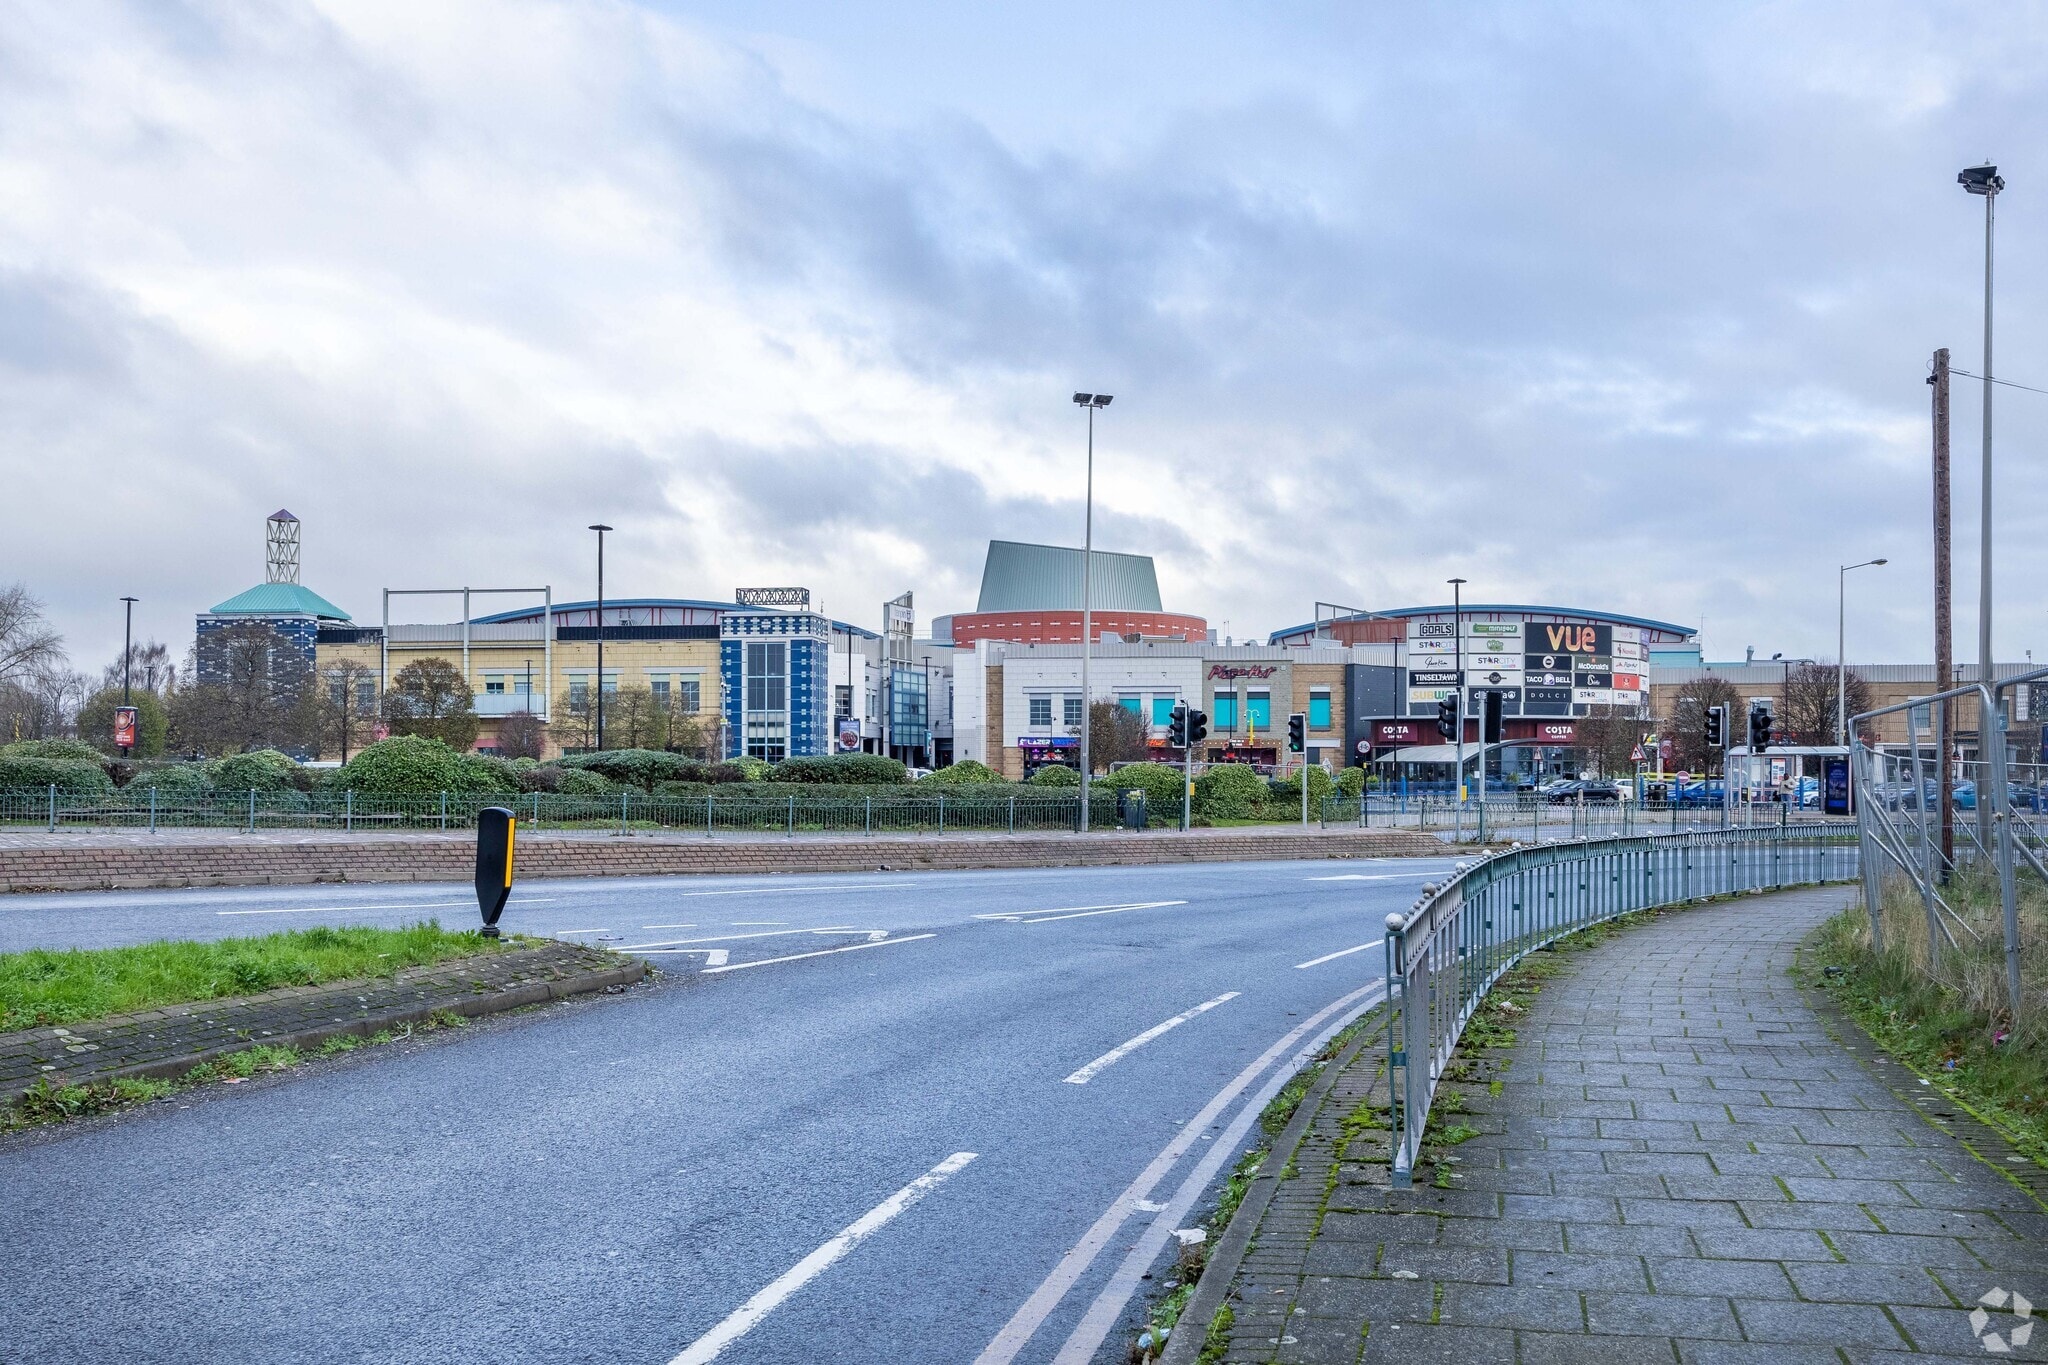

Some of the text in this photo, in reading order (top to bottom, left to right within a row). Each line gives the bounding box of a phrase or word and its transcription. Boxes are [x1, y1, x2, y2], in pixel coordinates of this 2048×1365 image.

[1422, 625, 1452, 634] GOALS
[1578, 662, 1609, 670] McDonald's
[1545, 726, 1573, 734] COSTA
